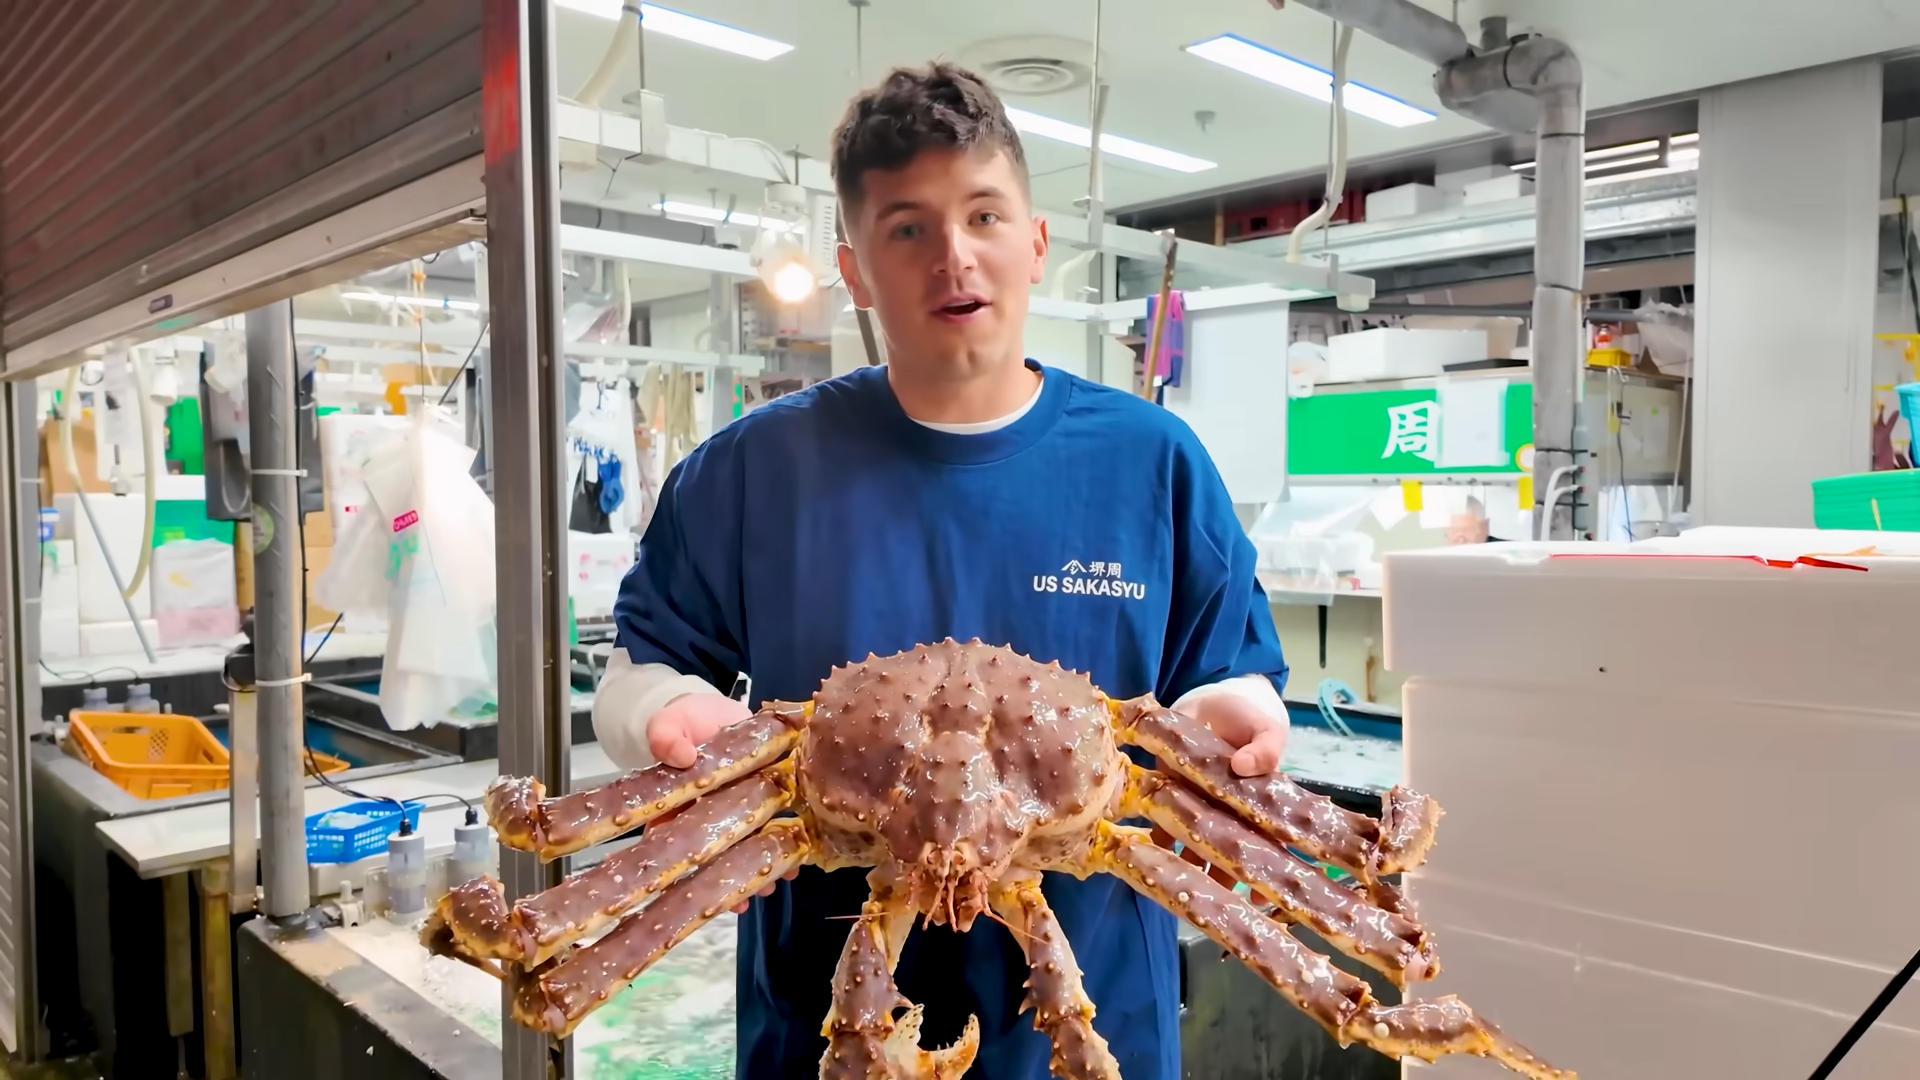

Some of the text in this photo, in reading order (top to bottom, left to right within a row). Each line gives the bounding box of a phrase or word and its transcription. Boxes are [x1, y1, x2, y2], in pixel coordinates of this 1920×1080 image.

[1381, 400, 1441, 462] 周
[1089, 561, 1122, 578] 堺周
[1033, 575, 1145, 600] US SAKASYU
